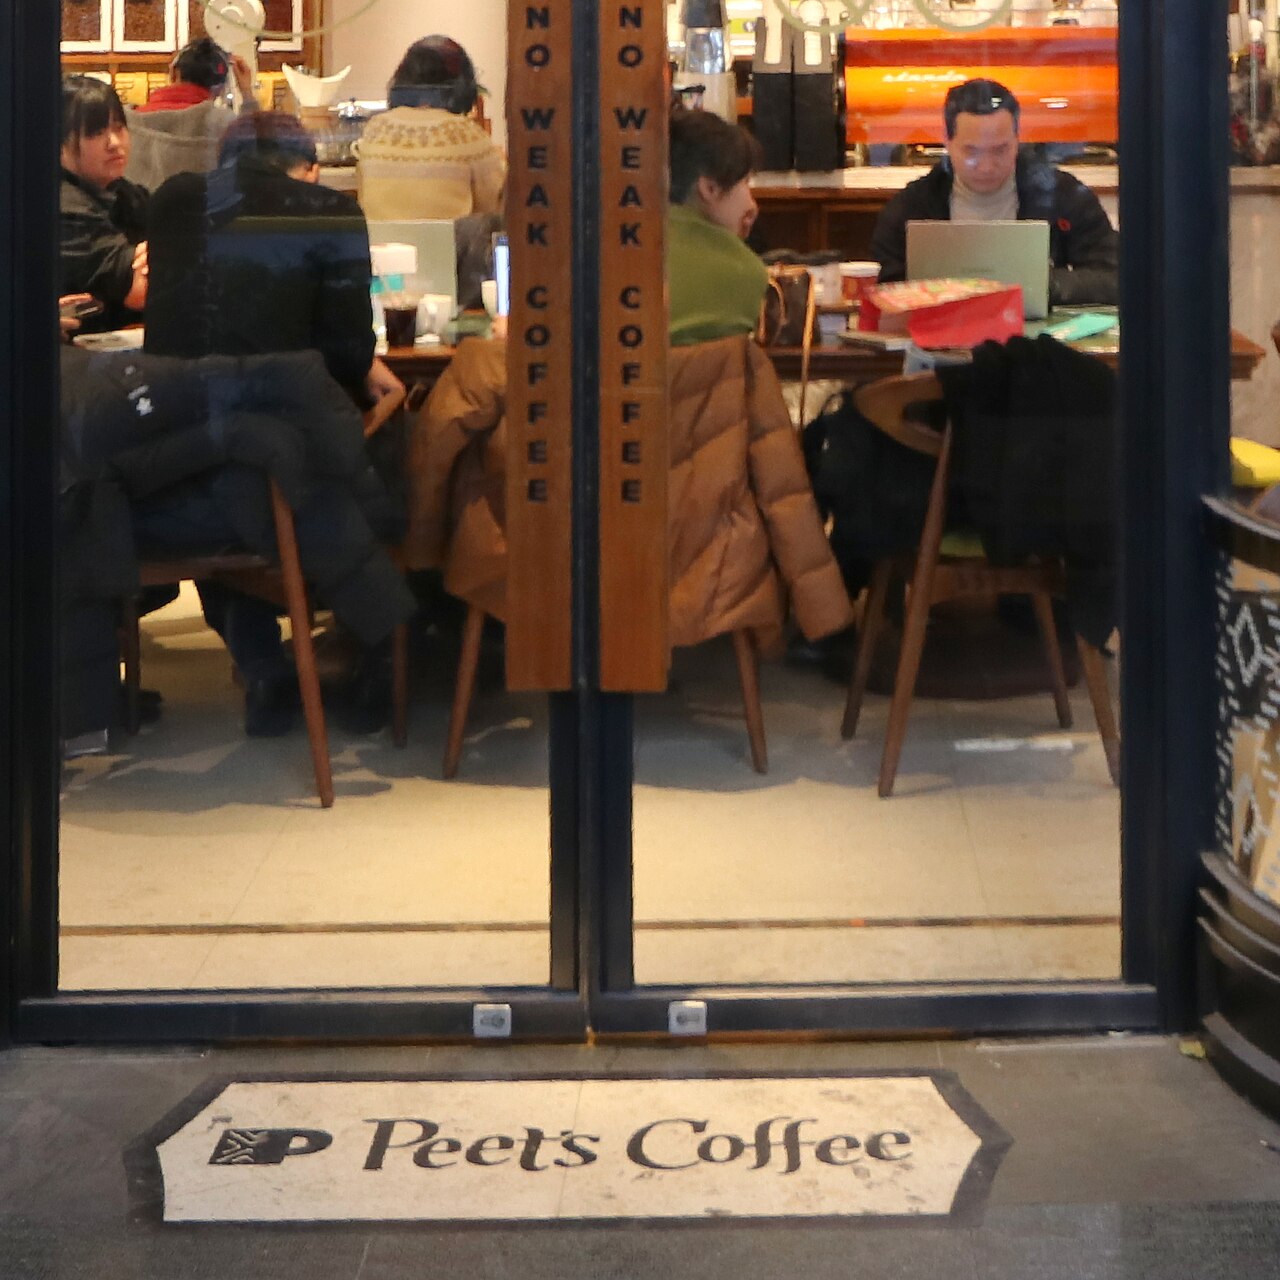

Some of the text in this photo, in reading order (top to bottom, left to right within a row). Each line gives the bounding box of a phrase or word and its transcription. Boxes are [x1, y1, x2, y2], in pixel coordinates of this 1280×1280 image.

[521, 6, 556, 503] NO WEAK COFFEE
[614, 6, 648, 503] NO WEAK COFFEE
